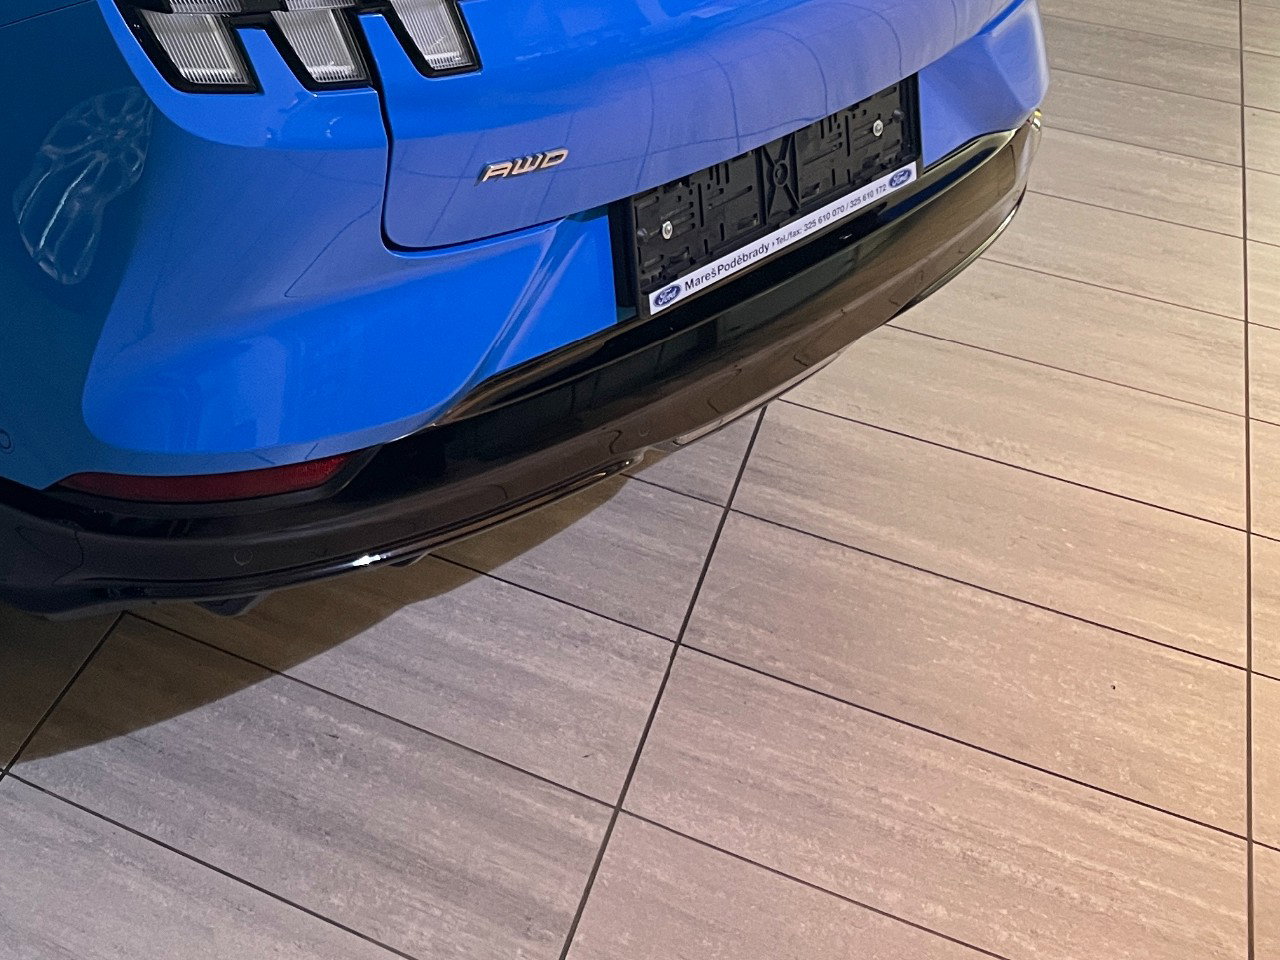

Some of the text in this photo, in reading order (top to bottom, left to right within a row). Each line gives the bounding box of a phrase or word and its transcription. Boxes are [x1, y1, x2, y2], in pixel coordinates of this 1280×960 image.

[479, 147, 569, 182] AWD
[890, 170, 910, 187] Ford
[804, 220, 817, 232] 325
[818, 213, 831, 224] 610
[832, 205, 845, 217] 070
[850, 196, 861, 208] 325
[862, 190, 874, 202] 610
[875, 184, 887, 195] 172
[657, 287, 679, 306] Ford
